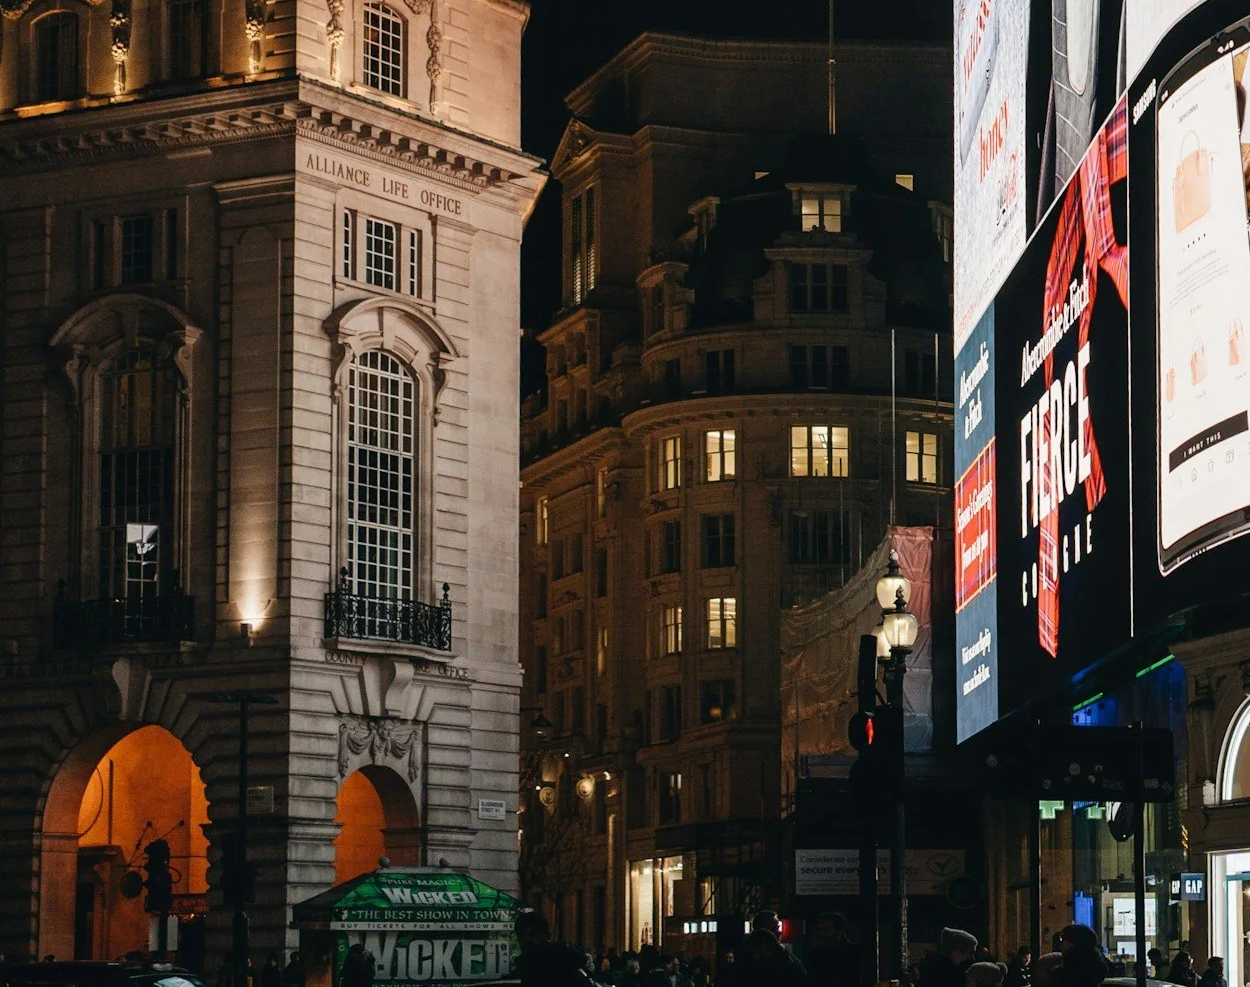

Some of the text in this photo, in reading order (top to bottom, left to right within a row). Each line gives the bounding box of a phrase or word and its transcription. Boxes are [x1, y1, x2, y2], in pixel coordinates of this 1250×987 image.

[306, 153, 462, 215] ALLIANCE LIFE OFFICE
[1021, 263, 1090, 388] Abercrombie & Fitch
[1021, 340, 1091, 539] FIERCE
[1205, 431, 1222, 449] THIS
[1021, 513, 1093, 607] COLOGNE
[324, 650, 368, 666] COUNTY
[437, 662, 469, 678] OFFICE
[800, 866, 832, 875] secure
[1185, 880, 1203, 894] GAP
[384, 909, 413, 920] BEST
[416, 909, 454, 920] SHOW
[456, 909, 470, 920] IN
